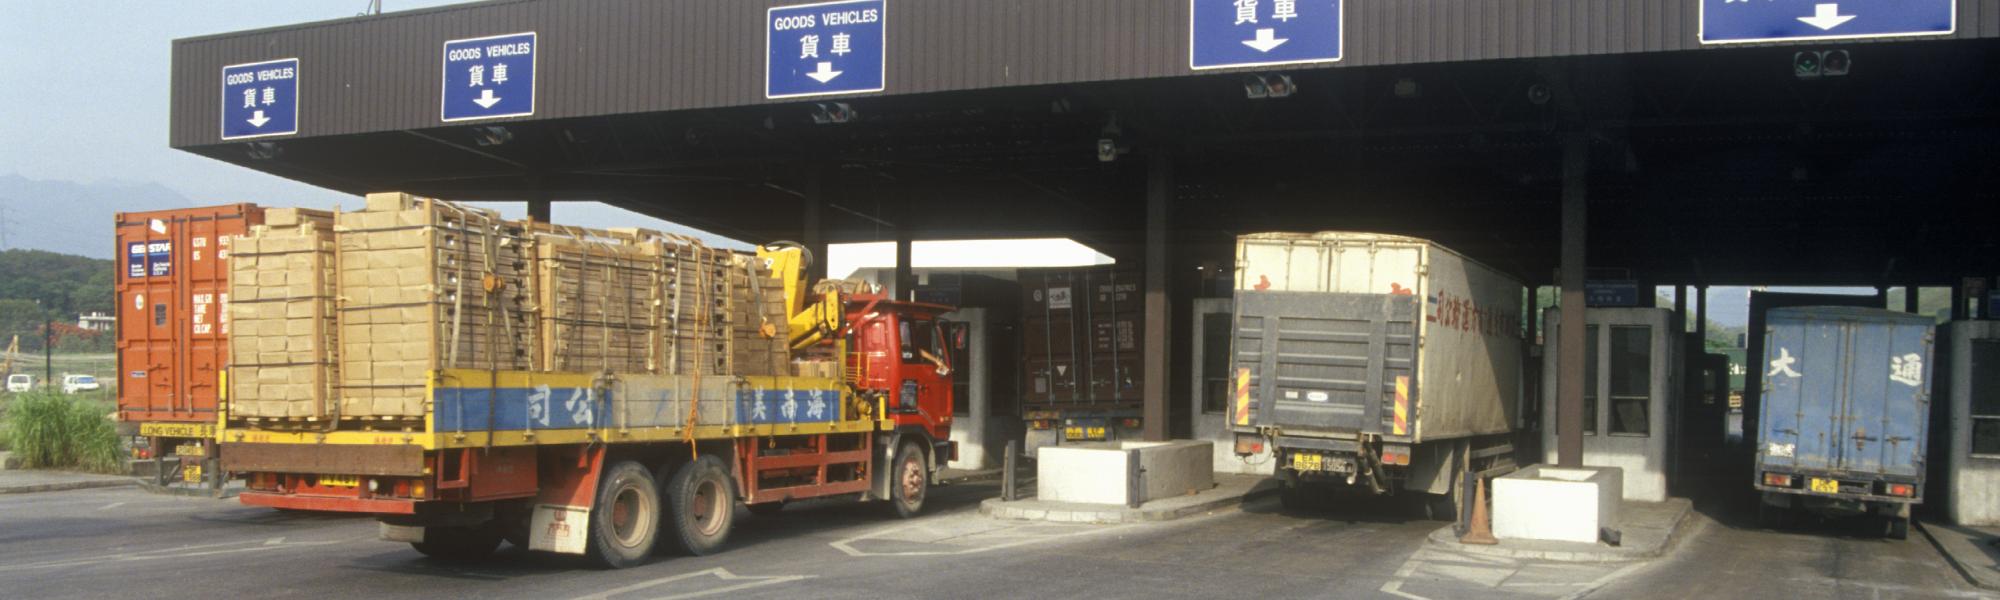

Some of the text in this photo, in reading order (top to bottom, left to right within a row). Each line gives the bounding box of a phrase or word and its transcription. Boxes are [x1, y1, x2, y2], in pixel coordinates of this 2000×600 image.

[775, 9, 878, 31] GOODS VEHICLES
[449, 42, 530, 61] GOODS VEHICLES
[800, 32, 851, 59] 貨車
[227, 67, 294, 85] GOODS VEHICLES
[469, 63, 508, 87] 貨車
[243, 86, 275, 108] 貨車
[143, 425, 163, 435] LONG
[165, 426, 193, 436] VEHICLE
